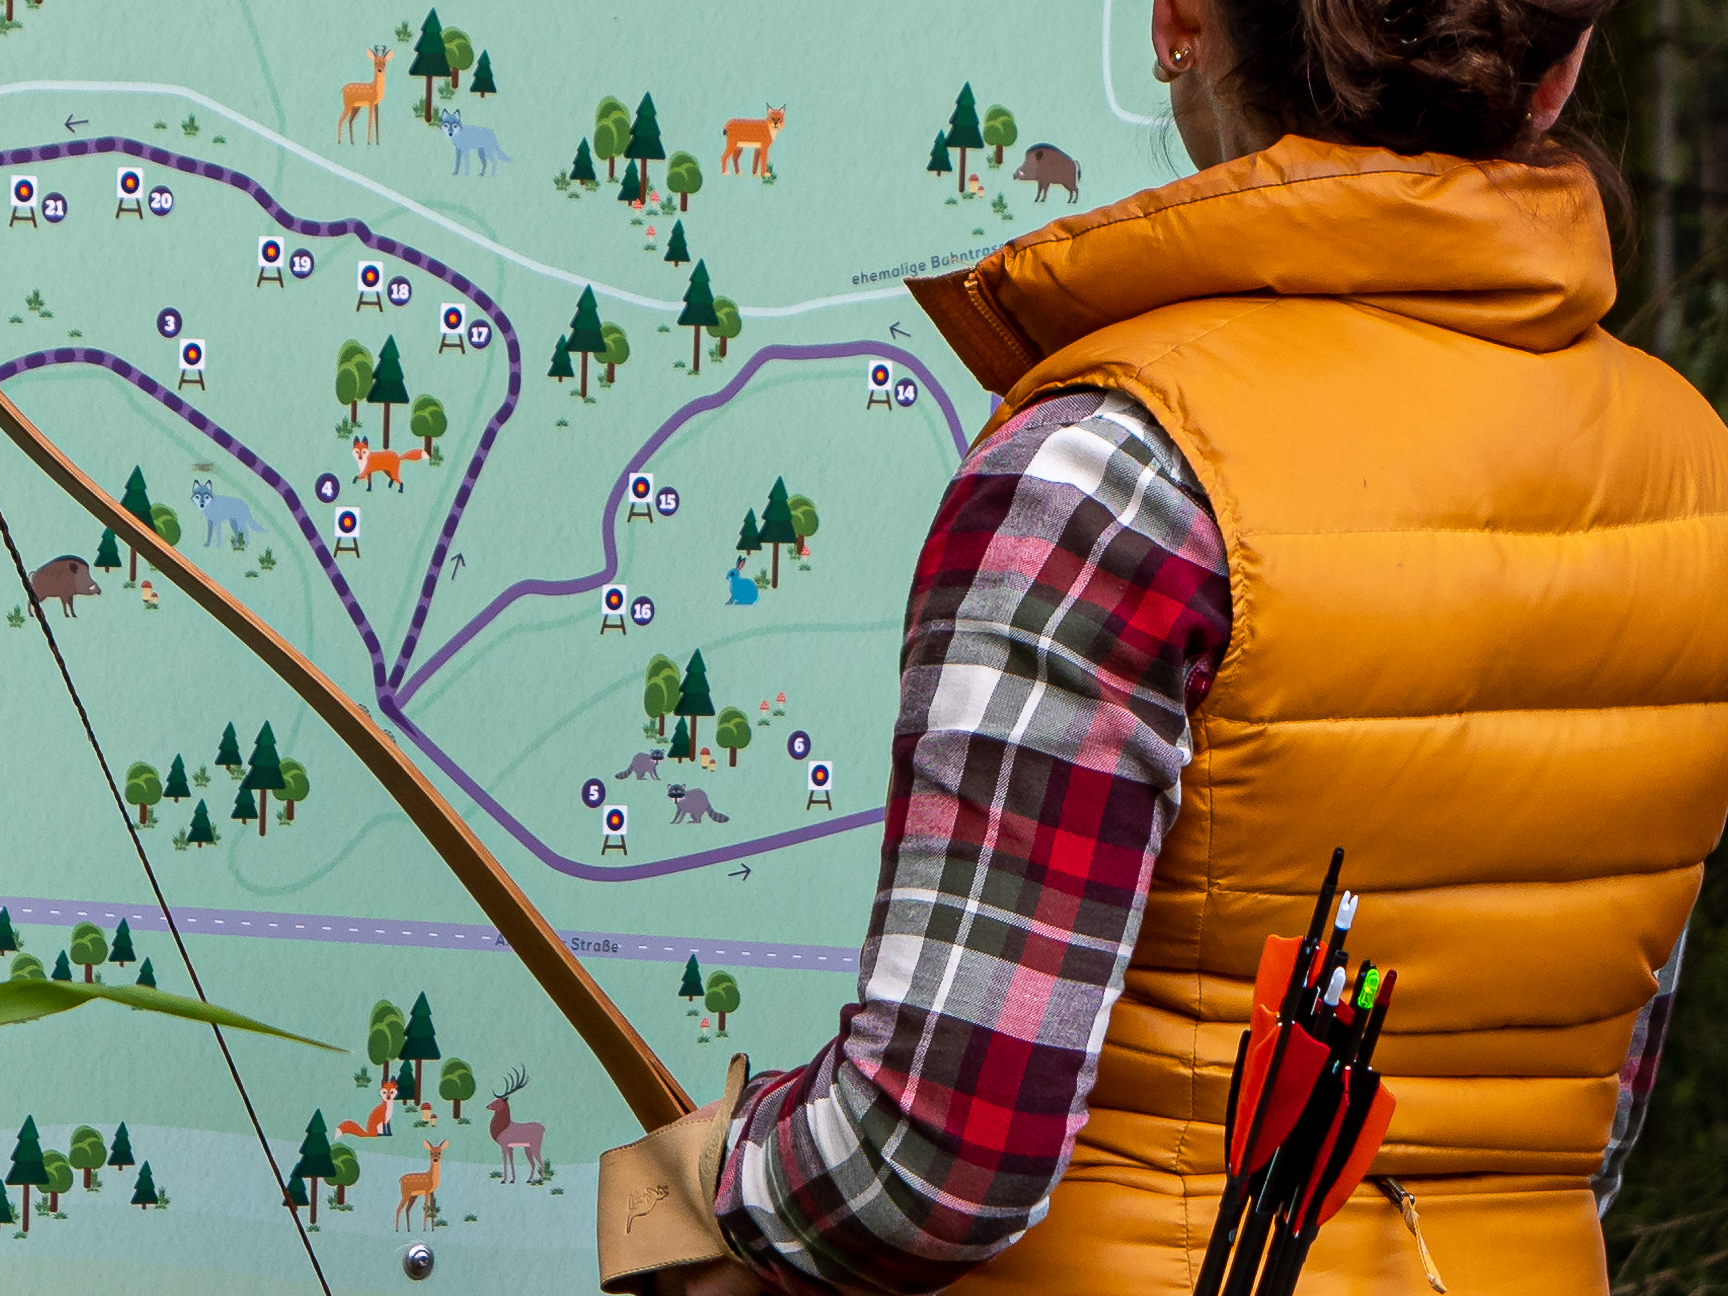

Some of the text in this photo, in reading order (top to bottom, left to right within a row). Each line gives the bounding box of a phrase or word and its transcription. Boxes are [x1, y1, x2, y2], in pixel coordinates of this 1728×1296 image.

[44, 199, 64, 216] 21
[150, 192, 172, 208] 20
[292, 256, 311, 272] 19
[852, 261, 927, 285] ehemalige
[390, 284, 409, 299] 18
[164, 315, 175, 332] 3
[470, 328, 489, 343] 17
[896, 385, 915, 401] 14
[321, 481, 333, 497] 4
[658, 494, 677, 509] 15
[633, 603, 651, 619] 16
[794, 737, 805, 753] 6
[589, 785, 599, 801] 5
[571, 937, 619, 953] Straße
